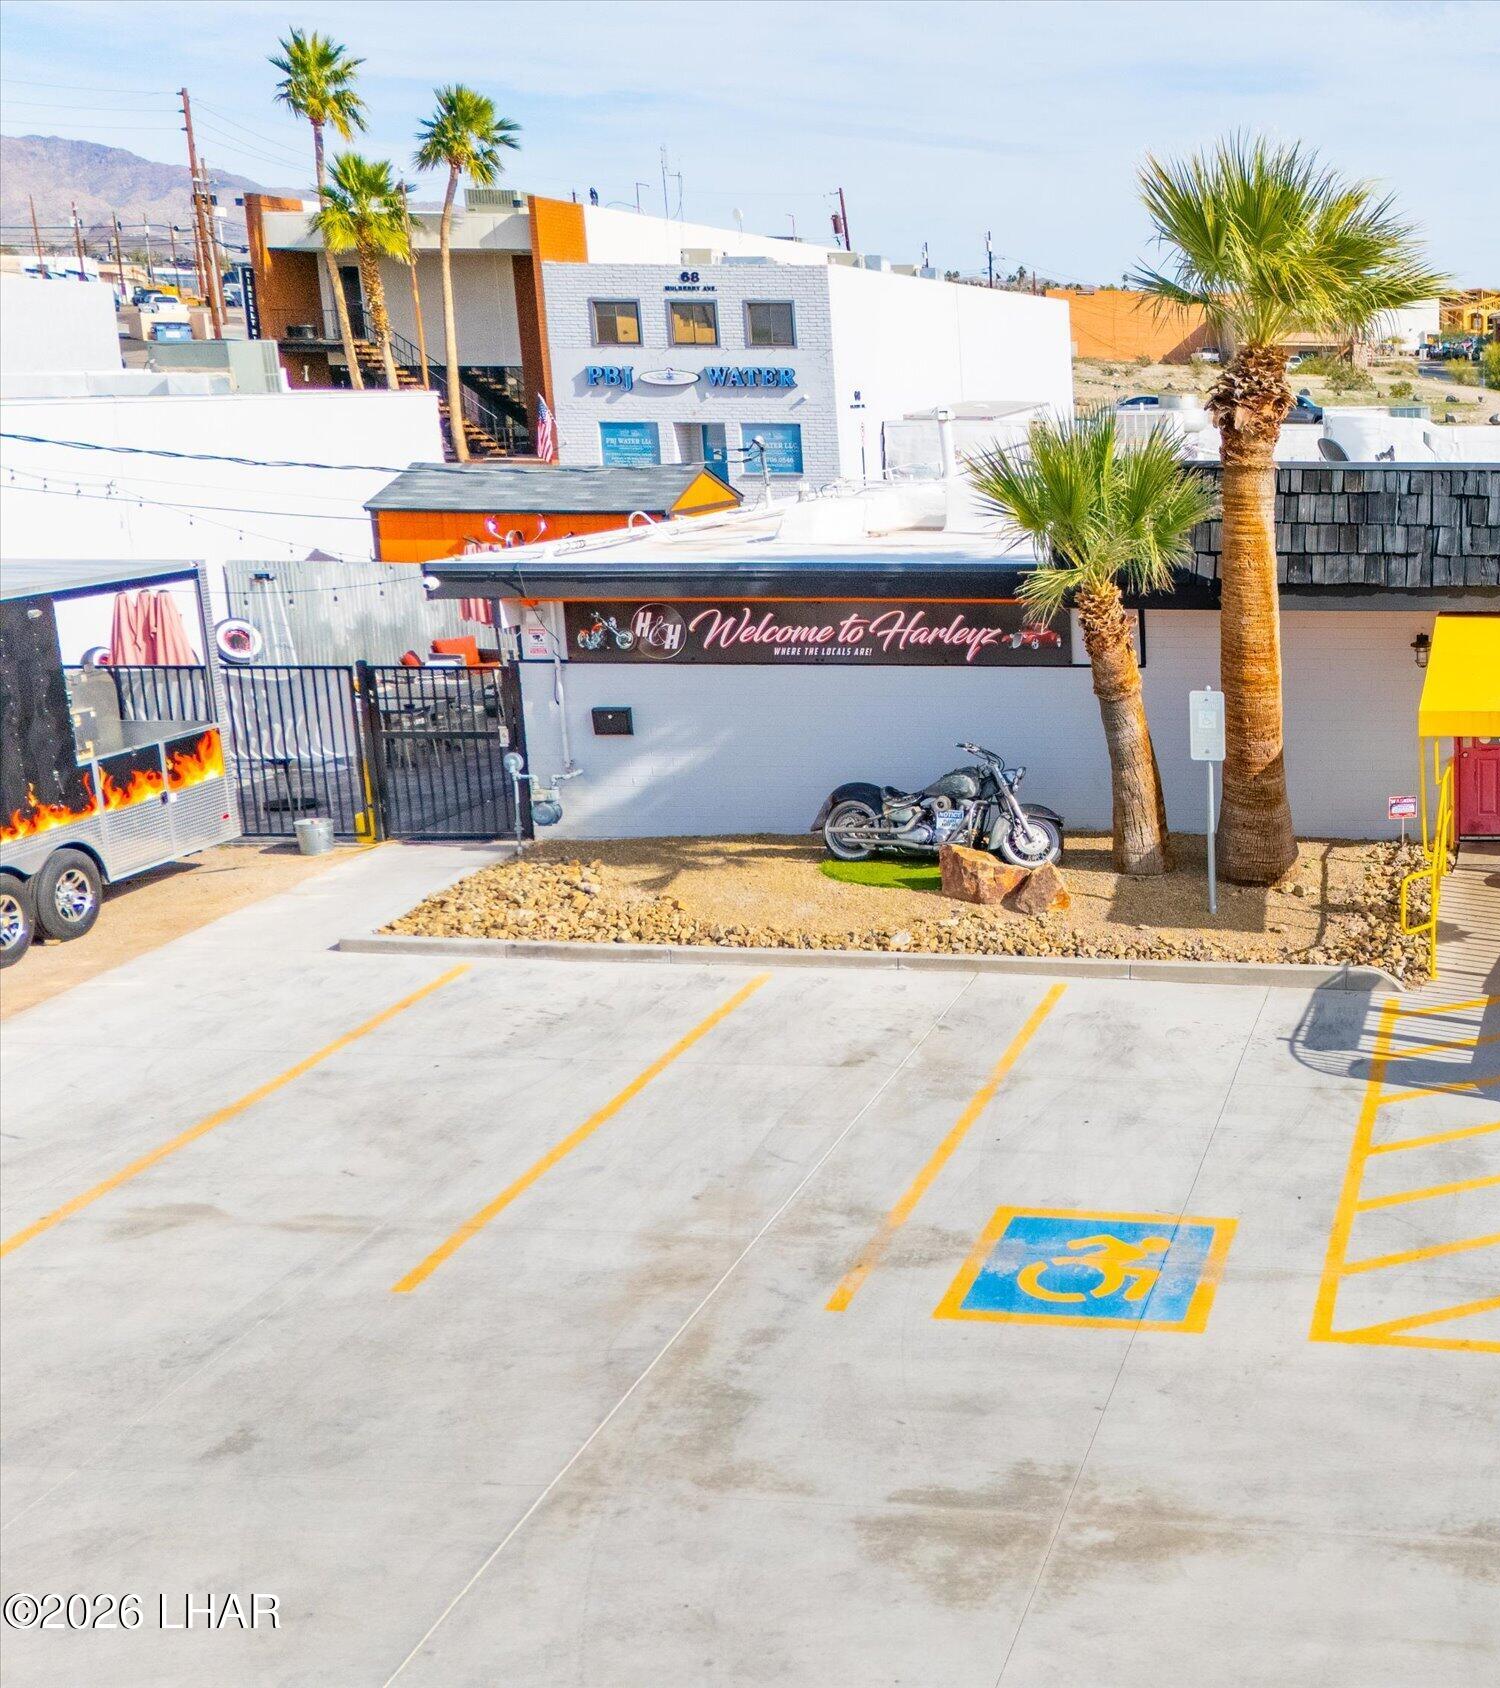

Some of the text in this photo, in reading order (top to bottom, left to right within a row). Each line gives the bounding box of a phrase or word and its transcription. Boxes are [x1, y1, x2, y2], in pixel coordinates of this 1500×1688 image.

[680, 271, 700, 283] 68
[585, 366, 798, 391] PBJ WATER
[688, 607, 1002, 662] Welcome to Harleyz
[774, 647, 873, 656] WHERE THE LOCALS ARE!
